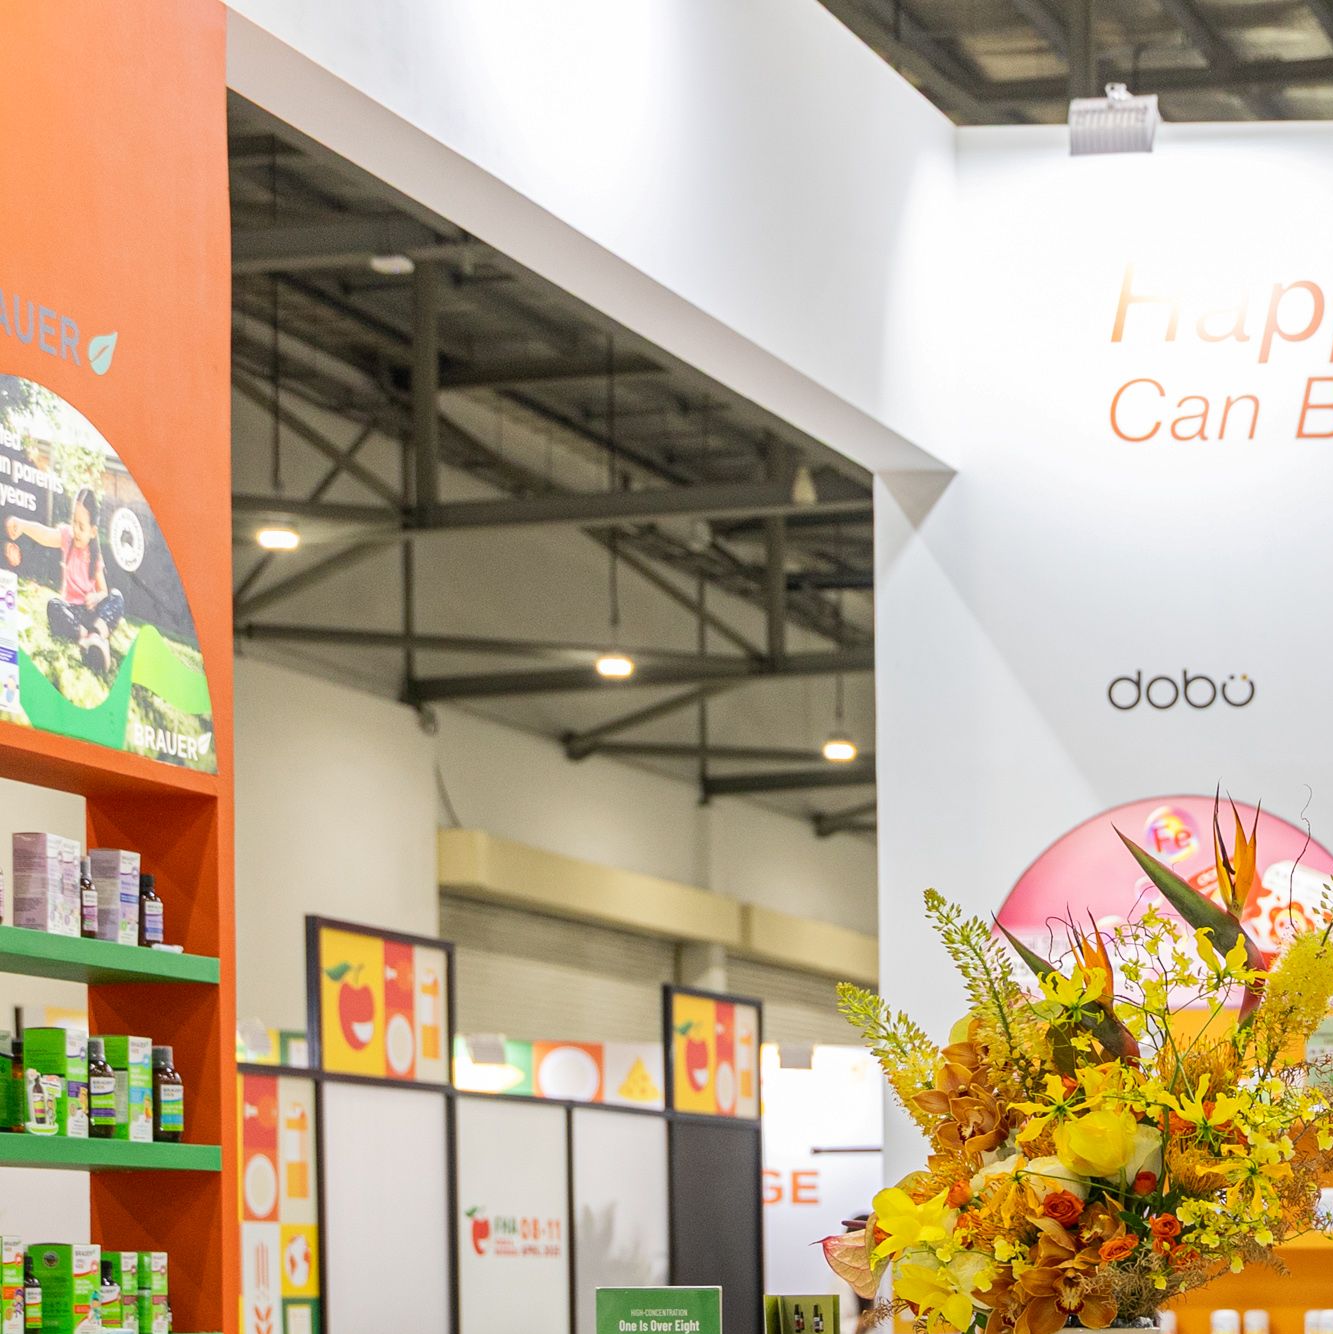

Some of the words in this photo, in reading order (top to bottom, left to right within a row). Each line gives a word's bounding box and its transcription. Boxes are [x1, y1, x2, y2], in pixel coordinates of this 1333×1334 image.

[1109, 378, 1260, 442] Can
[12, 460, 64, 494] parents
[1108, 669, 1255, 710] dobü
[133, 723, 198, 761] BRAUER
[1153, 826, 1191, 853] Fe
[619, 1320, 637, 1332] One
[639, 1320, 649, 1332] Is
[650, 1320, 672, 1332] Over
[674, 1319, 700, 1334] Eight
[631, 1309, 688, 1317] HIGH-CONCENTRATION
